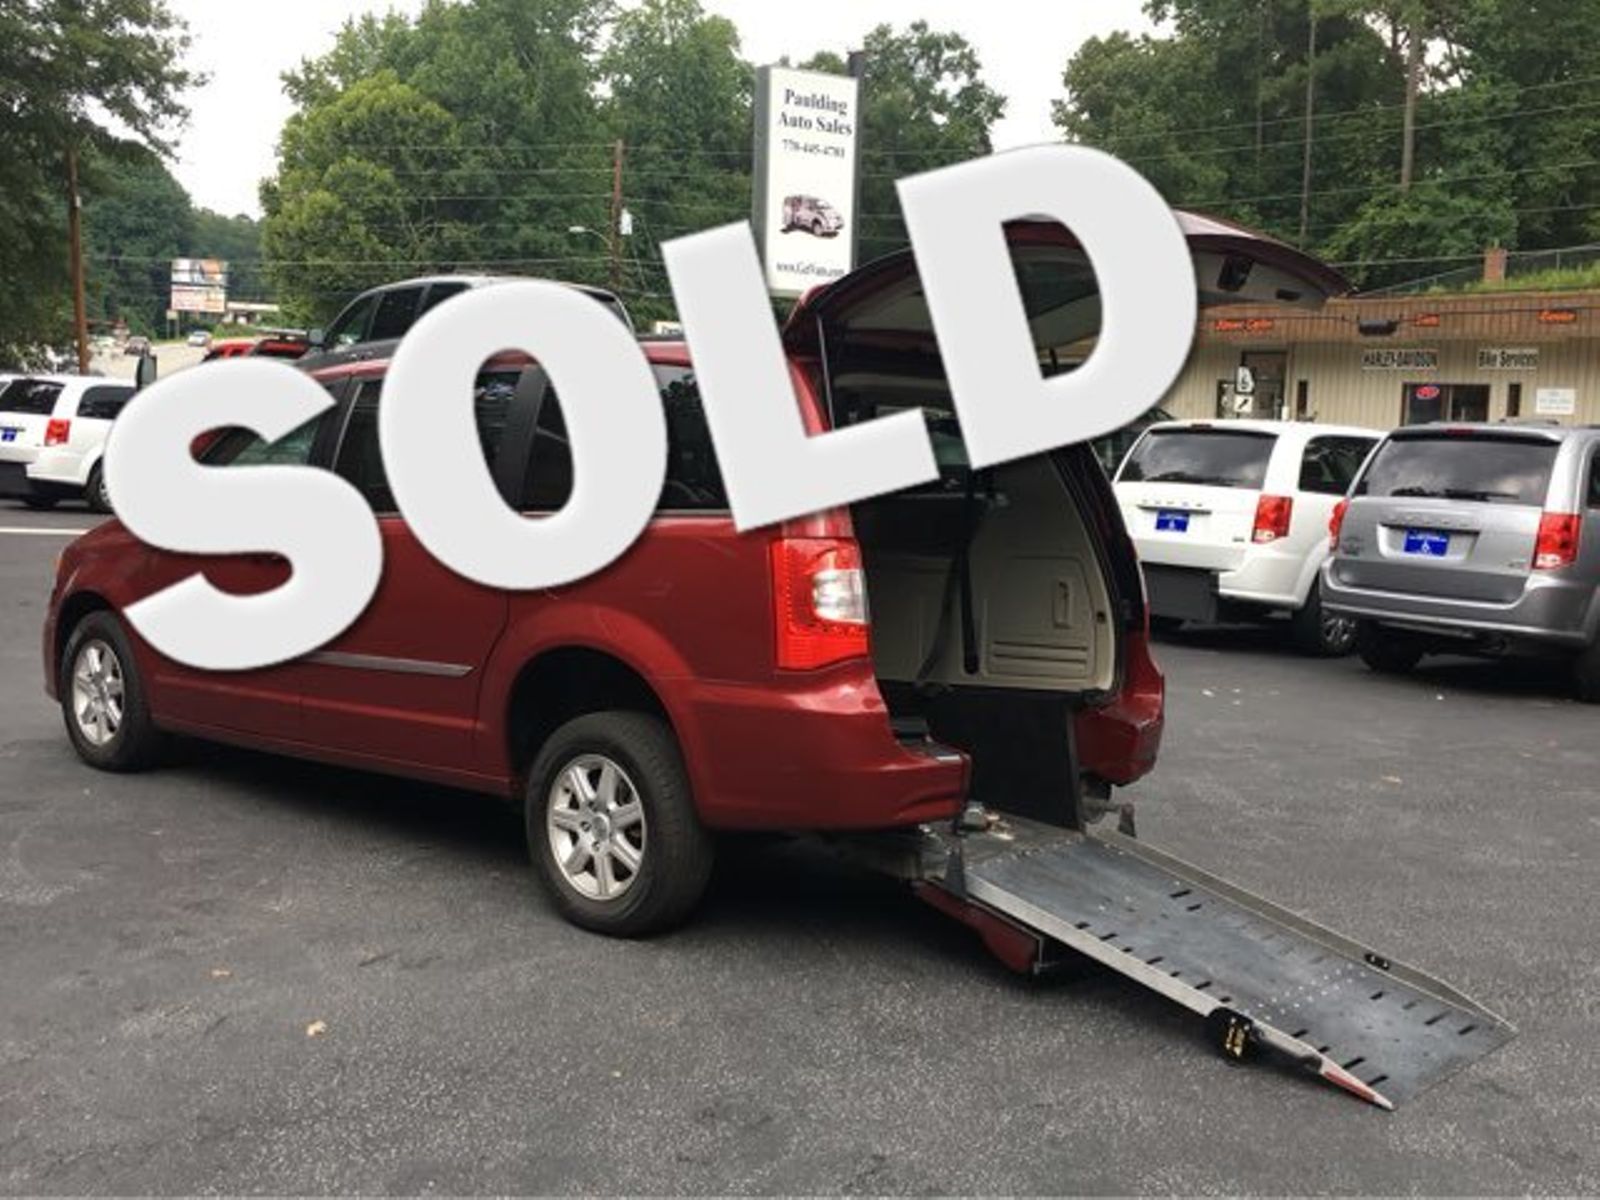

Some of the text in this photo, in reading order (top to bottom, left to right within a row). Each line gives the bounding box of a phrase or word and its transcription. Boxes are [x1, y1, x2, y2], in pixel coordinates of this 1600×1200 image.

[784, 88, 848, 116] Paulding
[778, 111, 852, 136] Auto Sales
